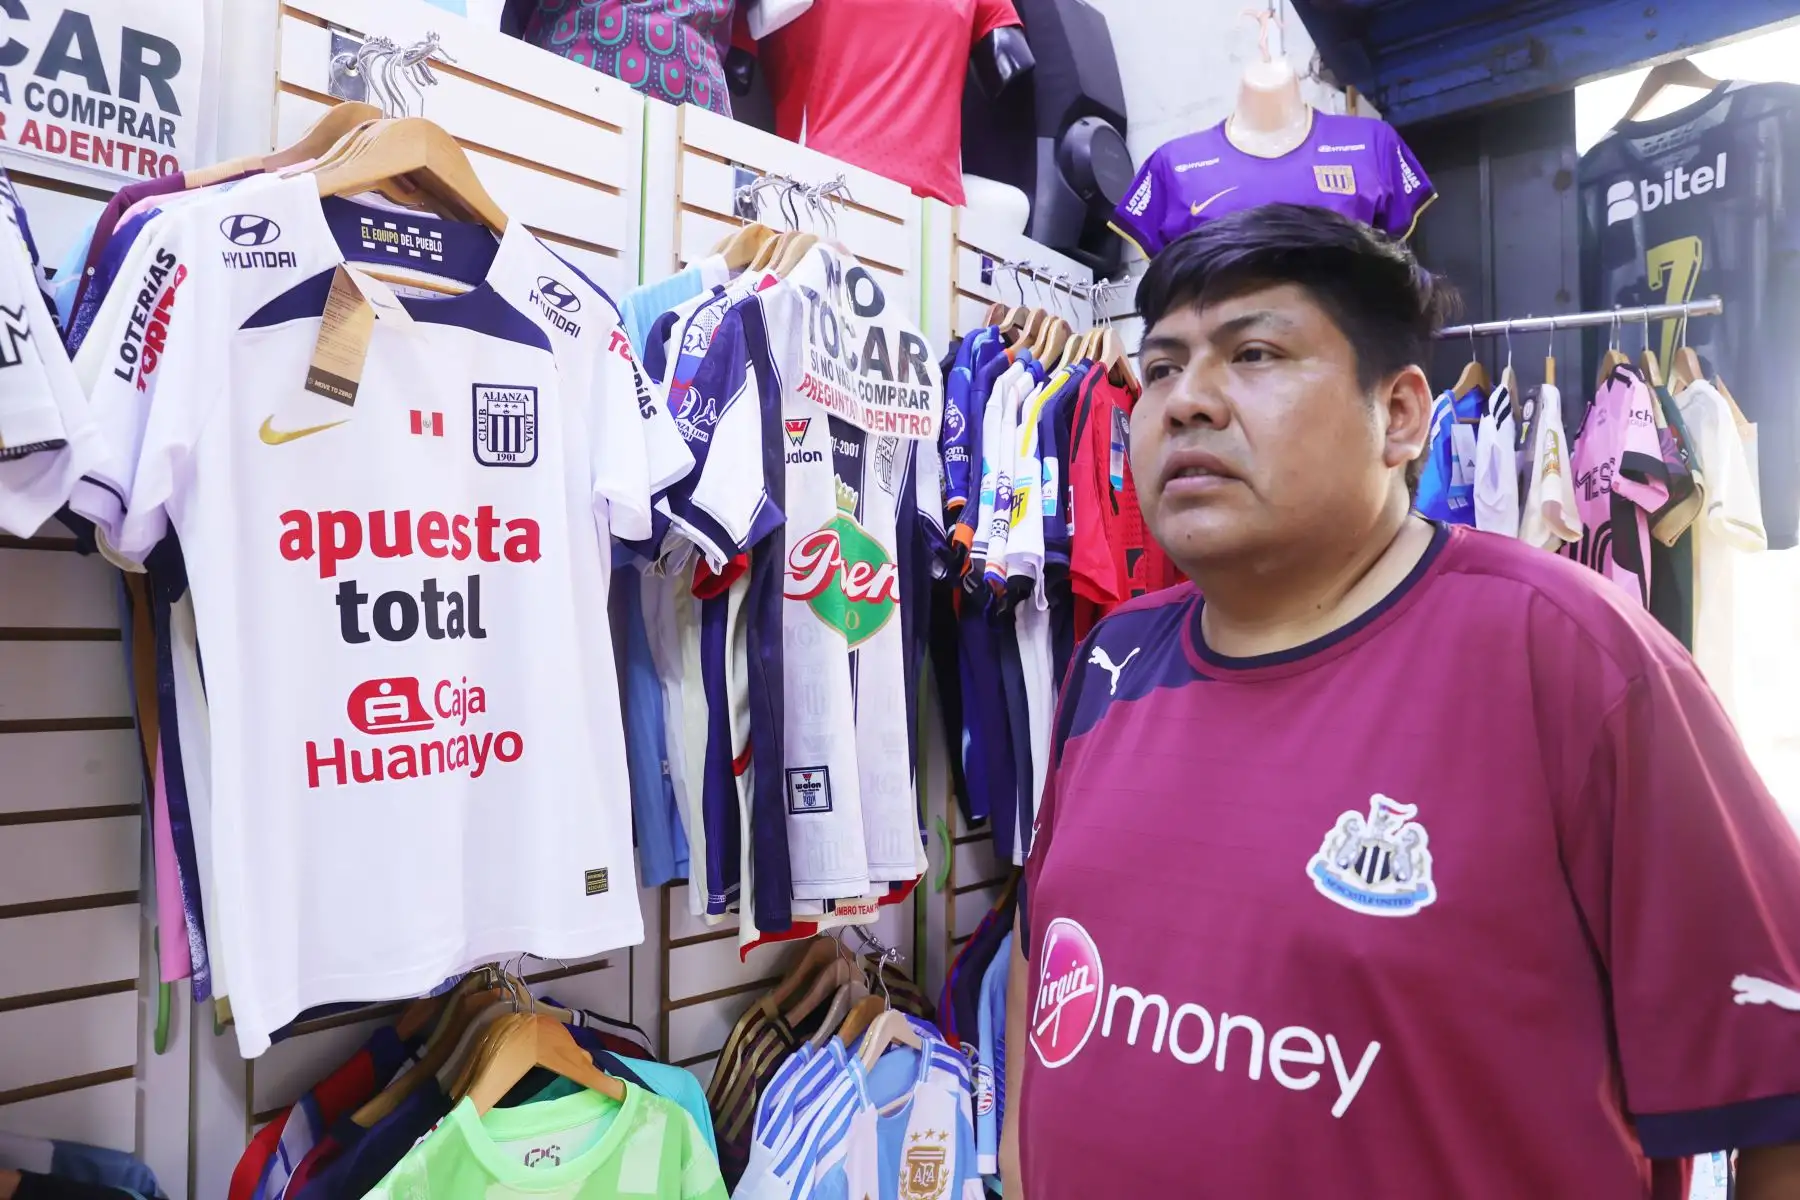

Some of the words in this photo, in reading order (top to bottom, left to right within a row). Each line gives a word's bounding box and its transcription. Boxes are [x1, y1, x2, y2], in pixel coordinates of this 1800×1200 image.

[24, 82, 176, 148] COMPRAR
[18, 119, 179, 179] ADENTRO
[1639, 152, 1728, 212] bitel
[222, 251, 298, 269] HYUNDAI
[361, 225, 372, 240] EL
[372, 227, 399, 245] EQUIPO
[400, 233, 414, 248] DEL
[415, 236, 443, 253] PUEBLO
[817, 248, 886, 318] NO
[1646, 236, 1703, 386] 7
[529, 289, 582, 339] HYUNDAI
[799, 284, 933, 388] TOCAR
[483, 391, 530, 402] ALIANZA
[810, 350, 820, 374] SI
[820, 355, 835, 382] NO
[858, 379, 931, 411] COMPRAR
[478, 408, 487, 442] CLUB
[525, 413, 534, 443] LIMA
[496, 453, 516, 462] 1901
[279, 505, 542, 579] apuesta
[335, 574, 487, 644] total
[434, 676, 486, 726] Caja
[305, 730, 524, 788] Huancayo
[834, 905, 857, 916] UMBRO
[1032, 933, 1096, 1048] Virgin
[1101, 983, 1382, 1119] money
